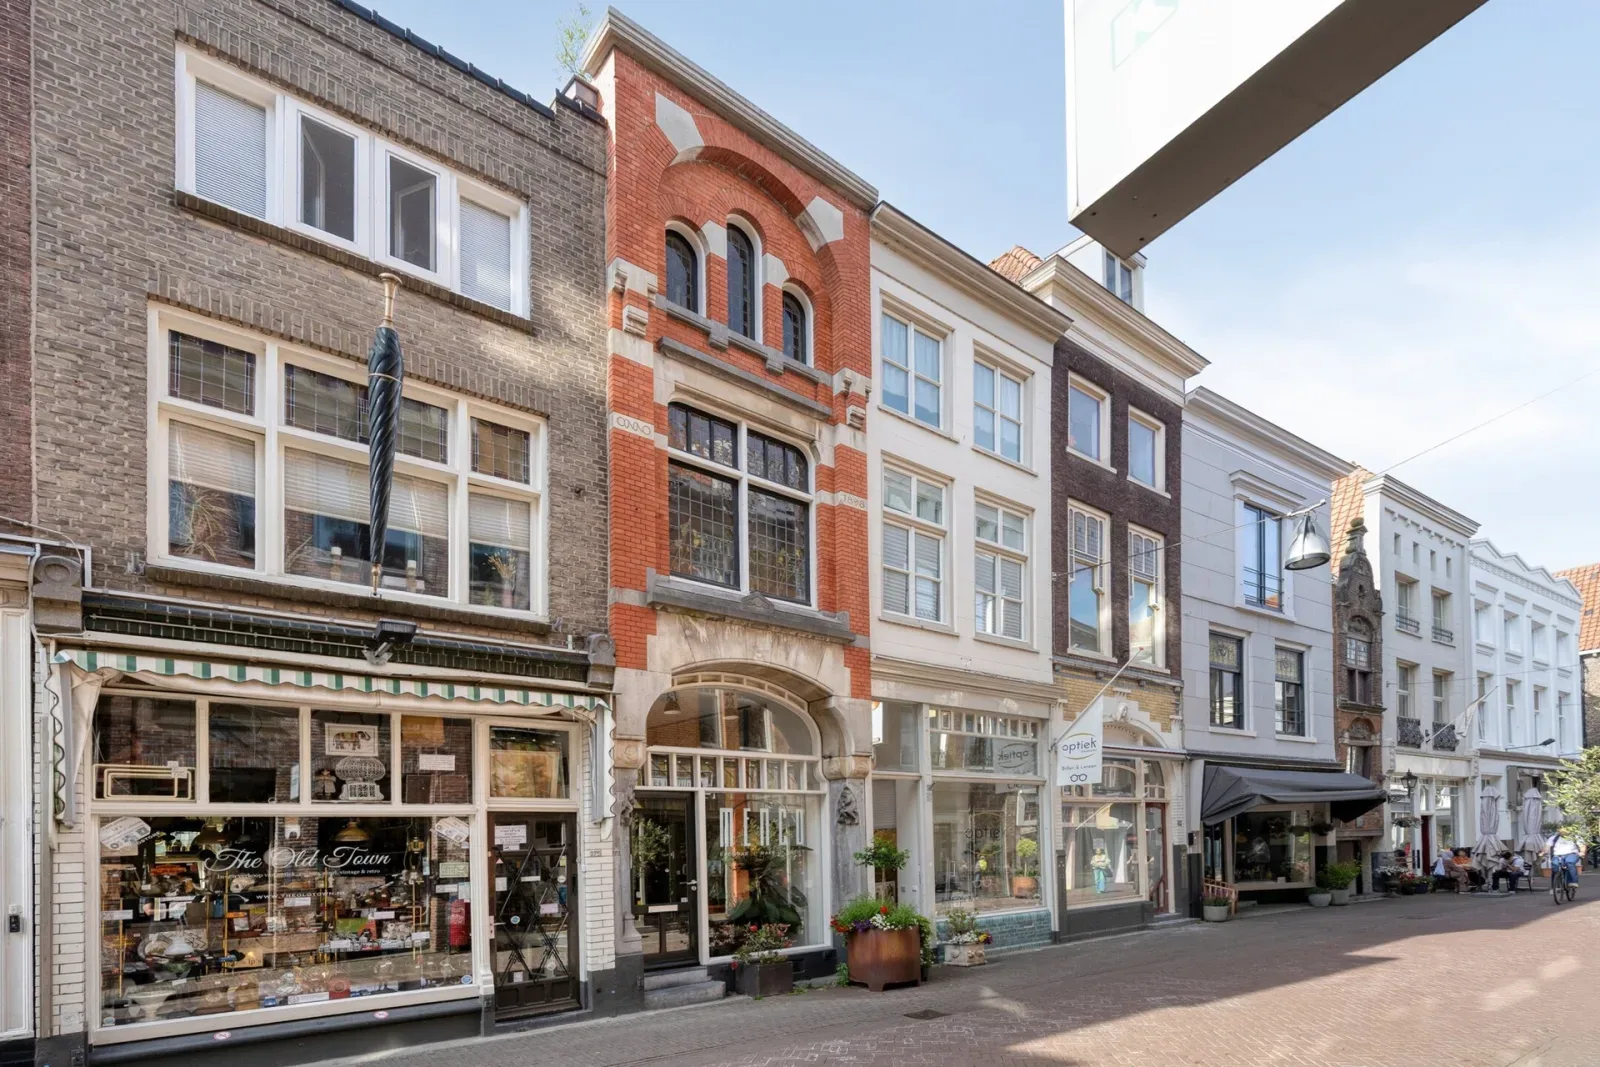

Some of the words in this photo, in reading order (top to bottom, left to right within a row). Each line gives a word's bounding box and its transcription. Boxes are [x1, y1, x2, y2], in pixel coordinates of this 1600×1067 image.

[1061, 737, 1097, 754] optiek
[965, 825, 1005, 844] optie
[204, 848, 263, 872] The
[269, 846, 318, 868] Old
[322, 846, 392, 868] Town
